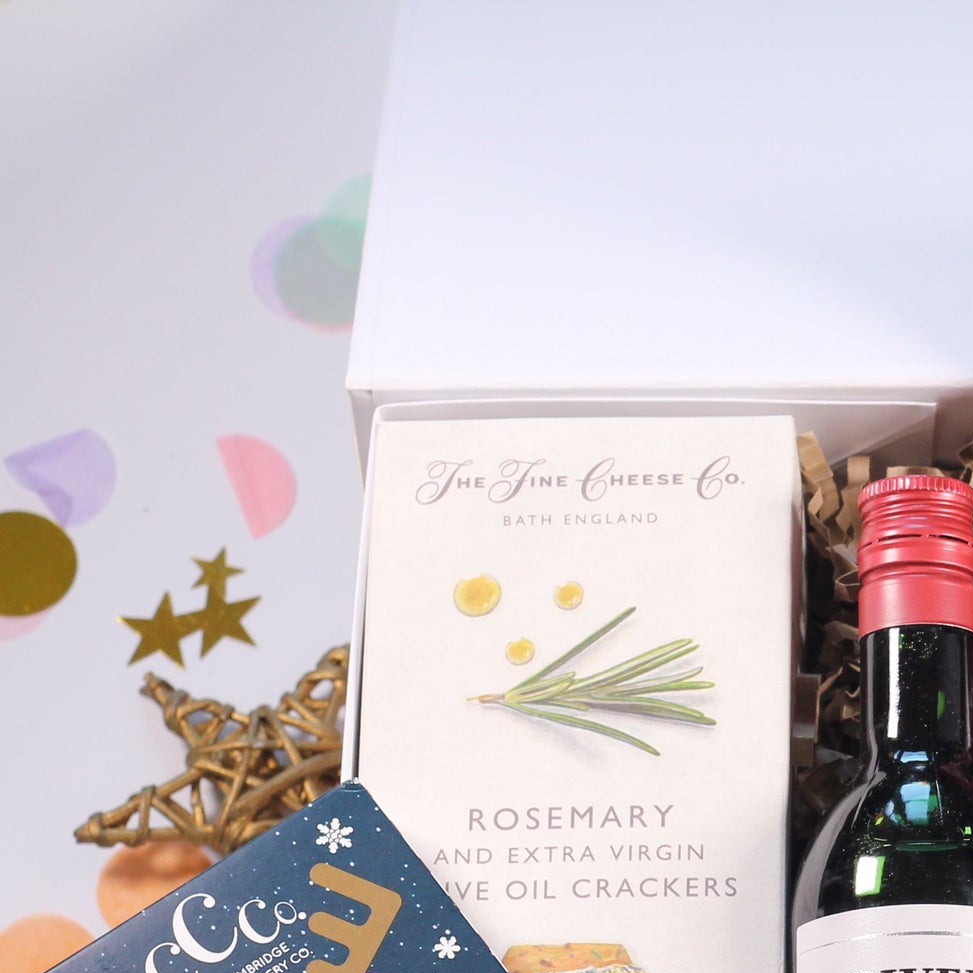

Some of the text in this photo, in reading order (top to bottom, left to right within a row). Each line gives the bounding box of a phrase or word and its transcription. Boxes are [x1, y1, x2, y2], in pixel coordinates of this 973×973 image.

[503, 512, 658, 526] BATH ENGLAND
[469, 804, 674, 832] ROSEMARY
[434, 844, 704, 865] AND EXTRA VIRGIN
[445, 877, 738, 901] IVE OIL CRACKERS
[289, 947, 314, 965] CO.
